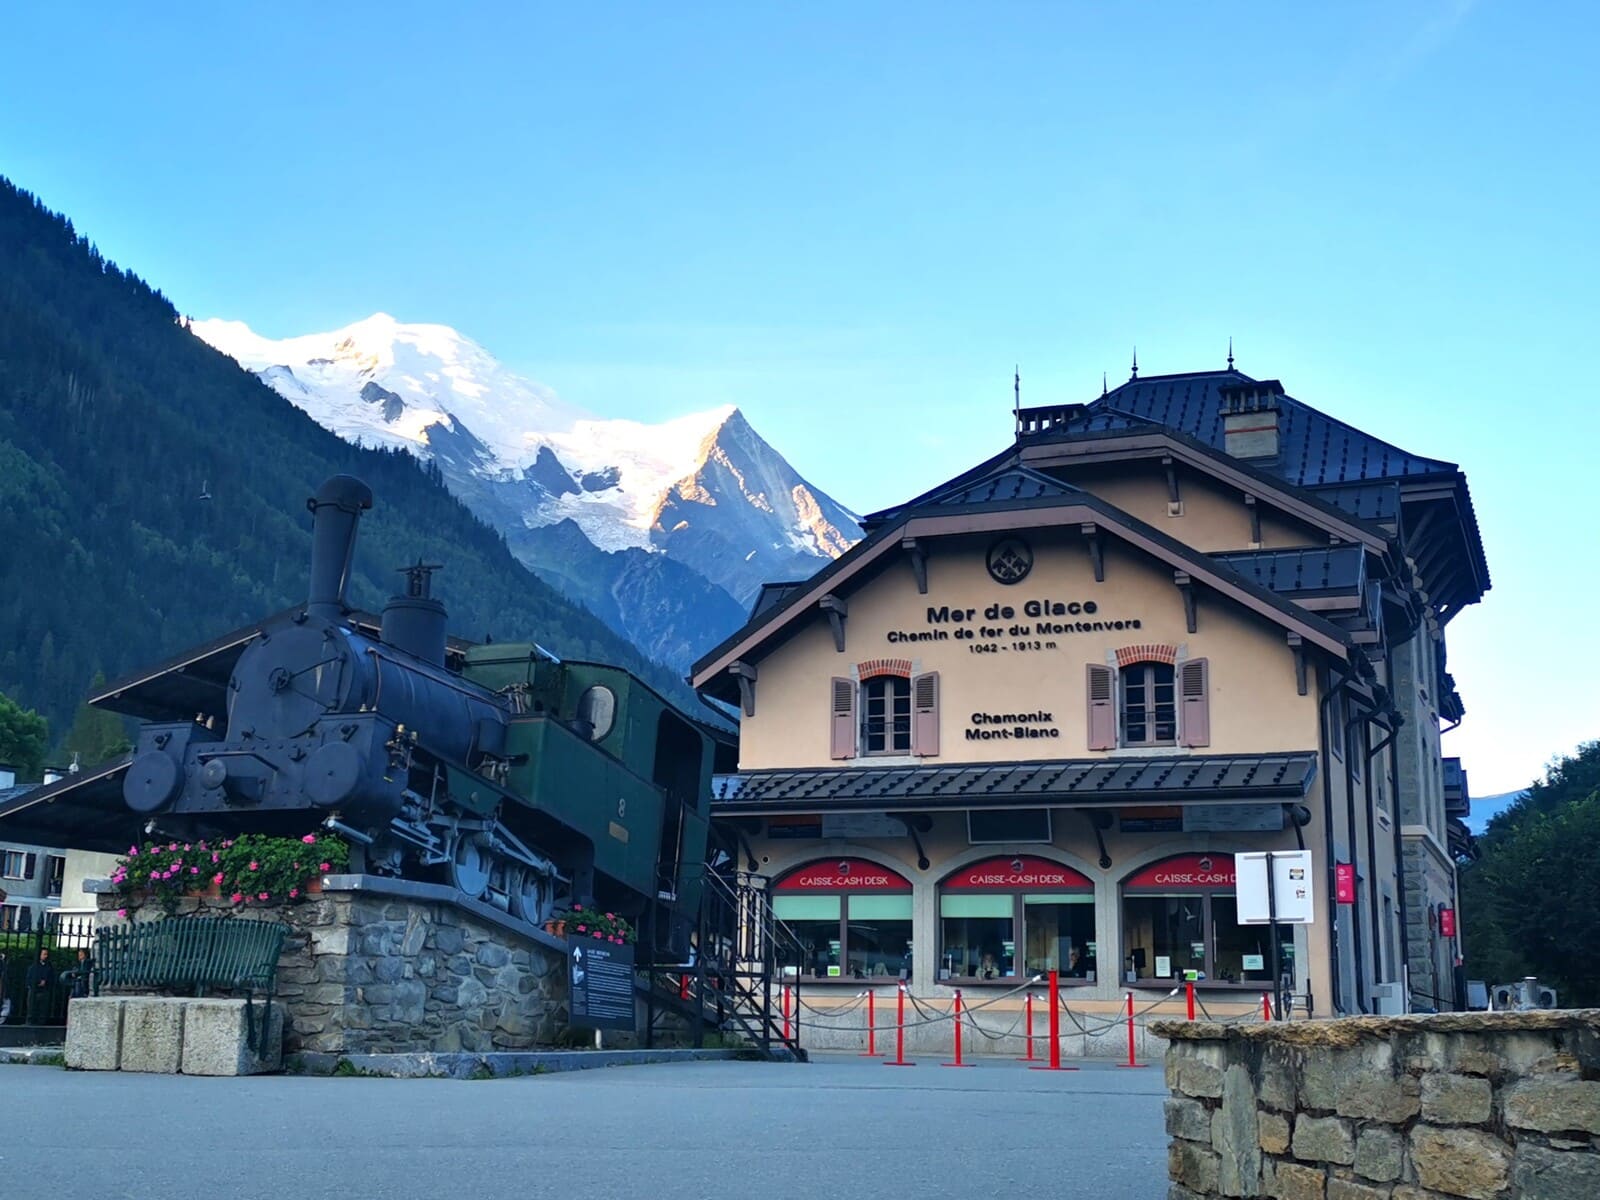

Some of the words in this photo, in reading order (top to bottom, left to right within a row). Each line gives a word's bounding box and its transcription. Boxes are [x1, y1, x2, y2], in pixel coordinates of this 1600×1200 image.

[927, 606, 976, 624] Mer
[984, 603, 1015, 620] de
[1024, 599, 1098, 618] Glace
[887, 629, 948, 643] Chemin
[954, 627, 974, 640] de
[980, 626, 1004, 638] fer
[1009, 624, 1030, 637] du
[969, 643, 998, 654] 1042
[1012, 641, 1041, 651] 1913
[1046, 641, 1057, 650] m
[971, 710, 1053, 725] Chamonix
[965, 726, 1060, 741] Mont-Blanc
[618, 797, 626, 818] 8
[800, 877, 862, 885] CAISSE-CASH
[865, 877, 888, 885] DESK
[970, 875, 1037, 884] CAISSE-CASH
[1040, 875, 1065, 883] DESK
[1155, 874, 1228, 883] CAISSE-CASH
